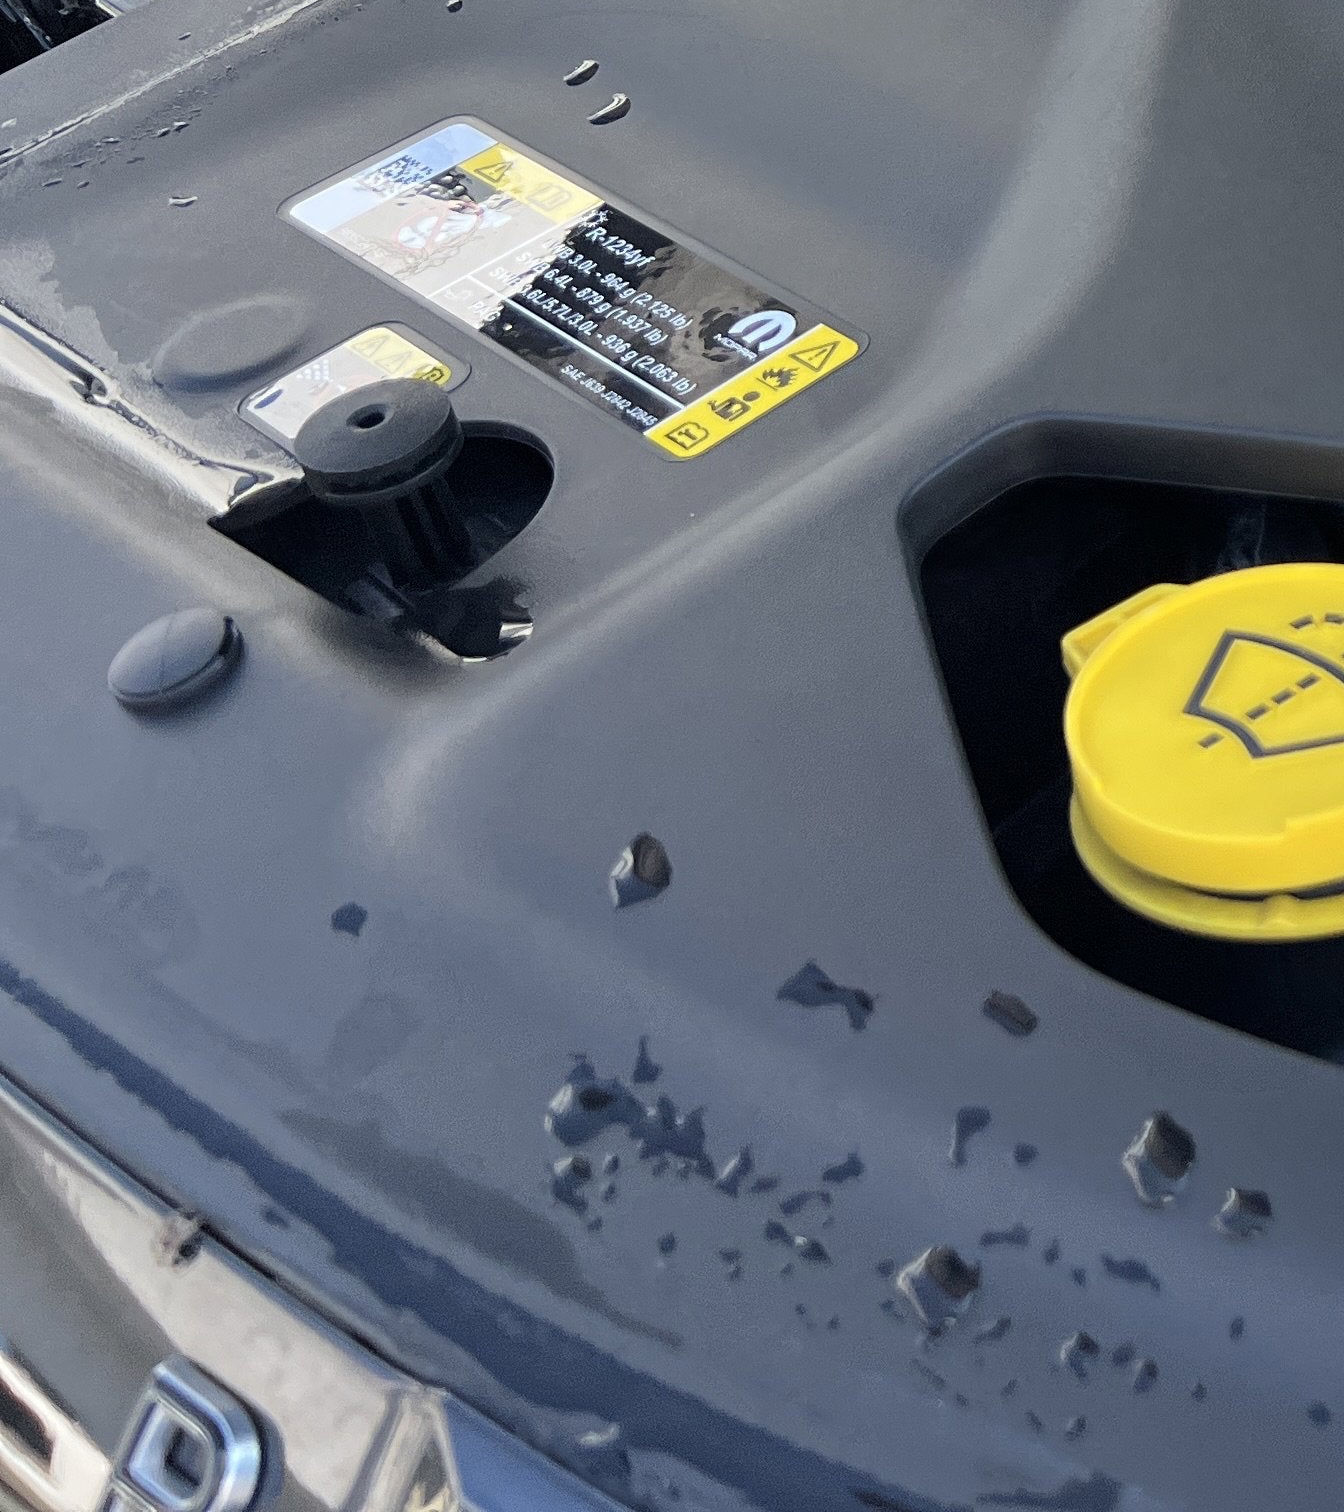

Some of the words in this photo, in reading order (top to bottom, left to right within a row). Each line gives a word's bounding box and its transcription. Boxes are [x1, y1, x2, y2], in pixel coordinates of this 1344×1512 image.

[585, 225, 654, 268] R-1234yf
[544, 267, 575, 289] 6.4L
[576, 286, 603, 306] 879
[605, 305, 650, 334] (1.937
[641, 327, 668, 346] lb)
[568, 253, 599, 274] 3.0L
[600, 272, 628, 291] 964
[629, 291, 676, 319] (2.125
[667, 312, 693, 331] lb)
[560, 363, 584, 381] SAE
[602, 333, 630, 354] 936
[631, 354, 678, 383] (2.063
[669, 376, 696, 396] lb)
